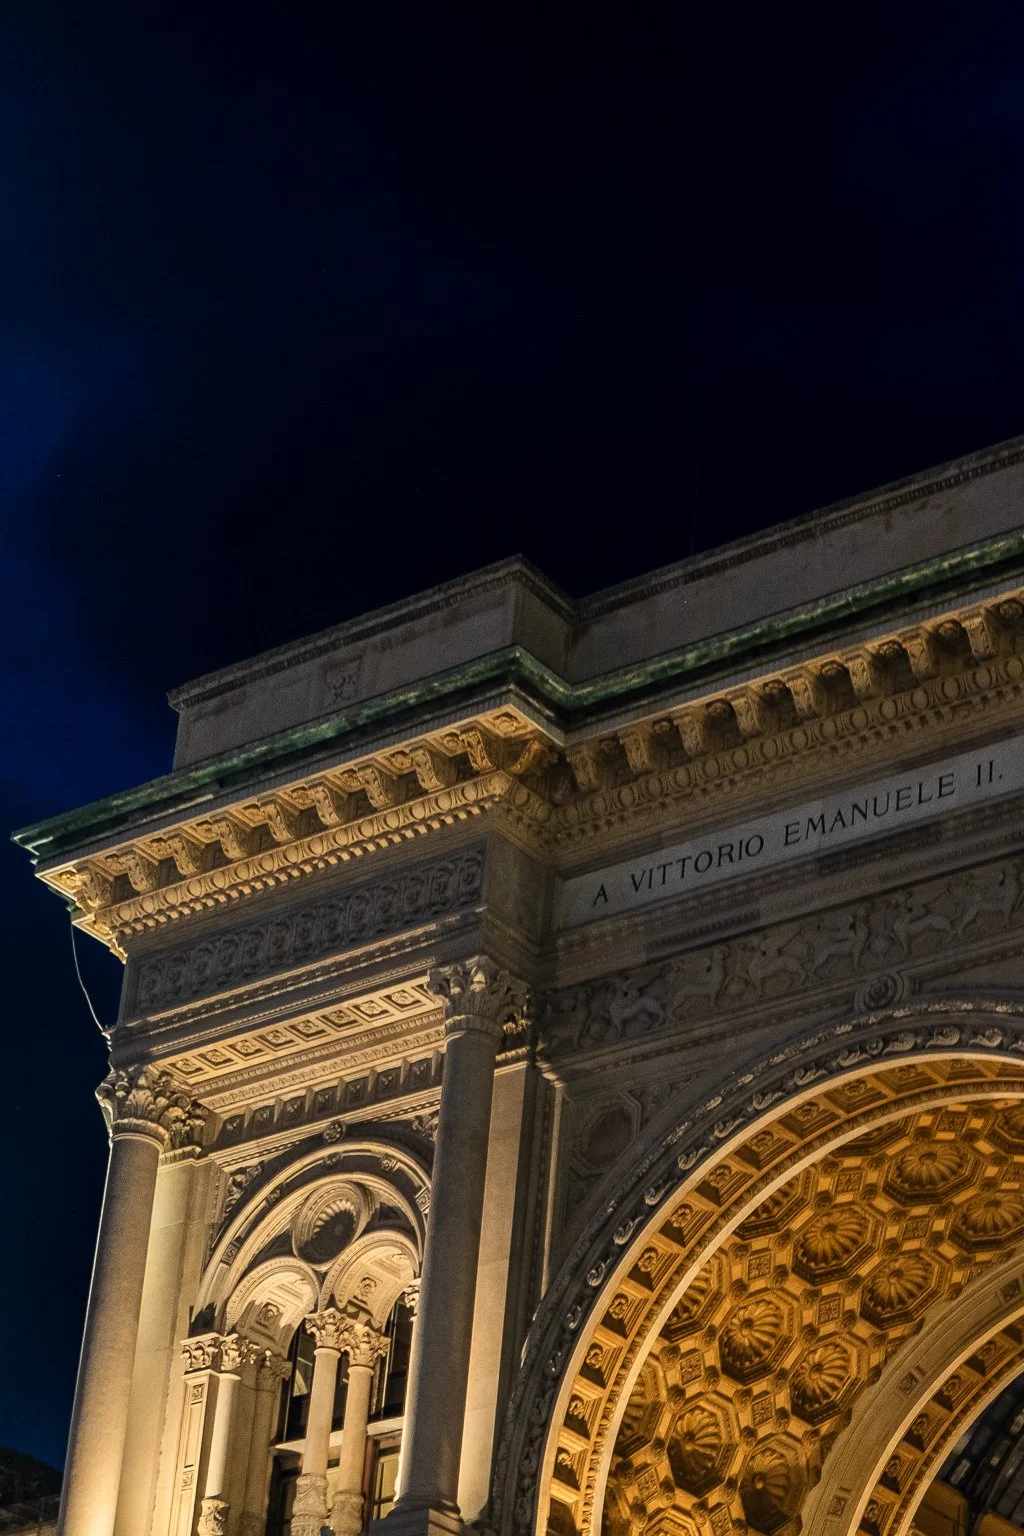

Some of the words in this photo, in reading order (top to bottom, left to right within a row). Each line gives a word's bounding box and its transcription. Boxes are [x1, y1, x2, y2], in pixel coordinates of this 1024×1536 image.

[592, 884, 609, 907] A
[630, 835, 764, 893] VITTORIO
[783, 773, 956, 846] EMANUELE
